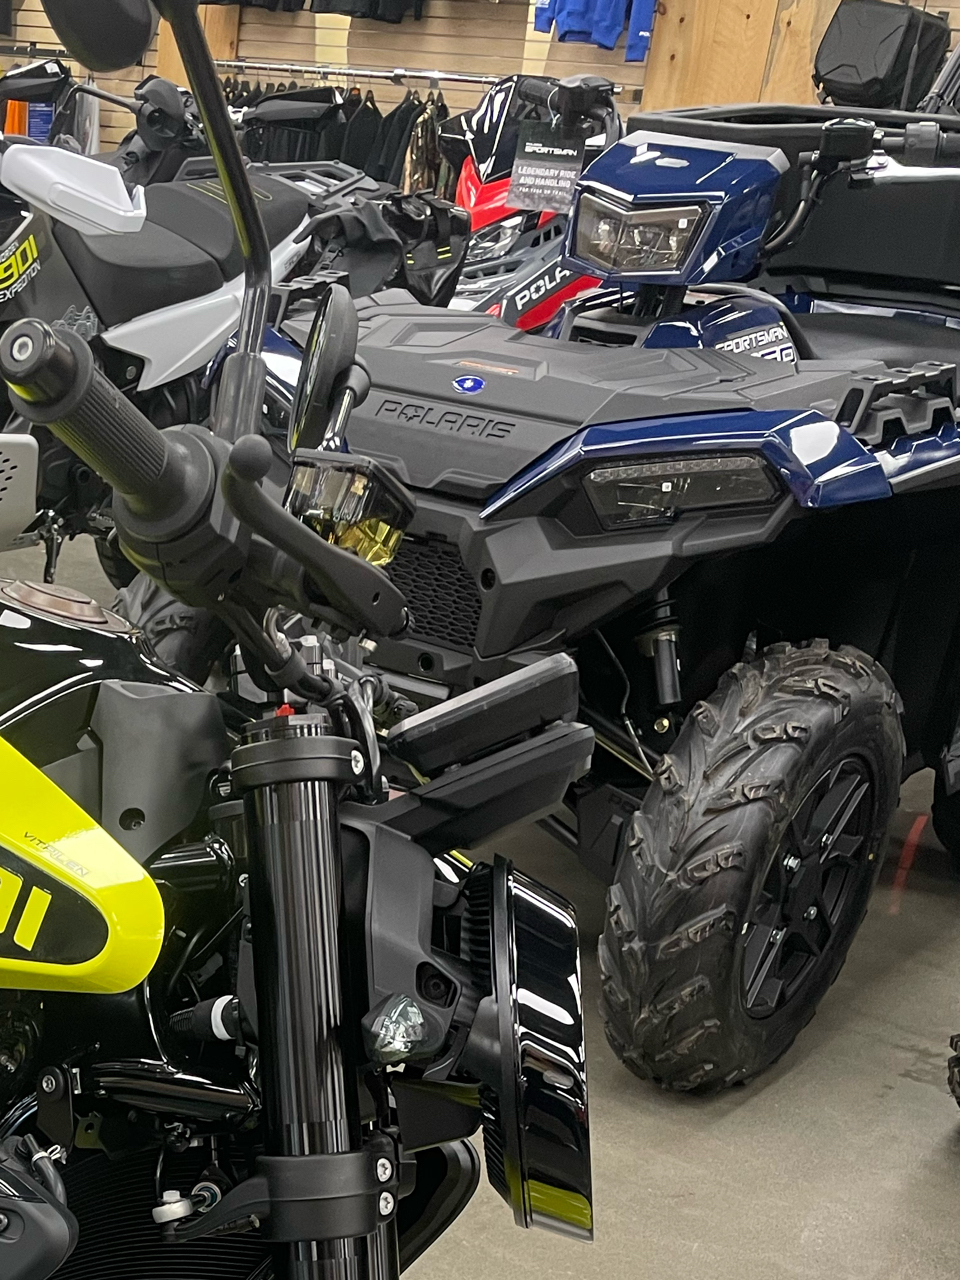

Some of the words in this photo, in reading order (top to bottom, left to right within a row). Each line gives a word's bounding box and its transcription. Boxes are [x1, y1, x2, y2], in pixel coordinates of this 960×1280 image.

[525, 145, 577, 156] SPORTSMAN
[518, 166, 559, 176] LEGENDARY
[560, 170, 576, 178] RIDE
[519, 176, 534, 184] AND
[535, 178, 570, 188] HANDLING
[375, 399, 517, 439] POLARIS
[24, 831, 91, 878] VITPILEN
